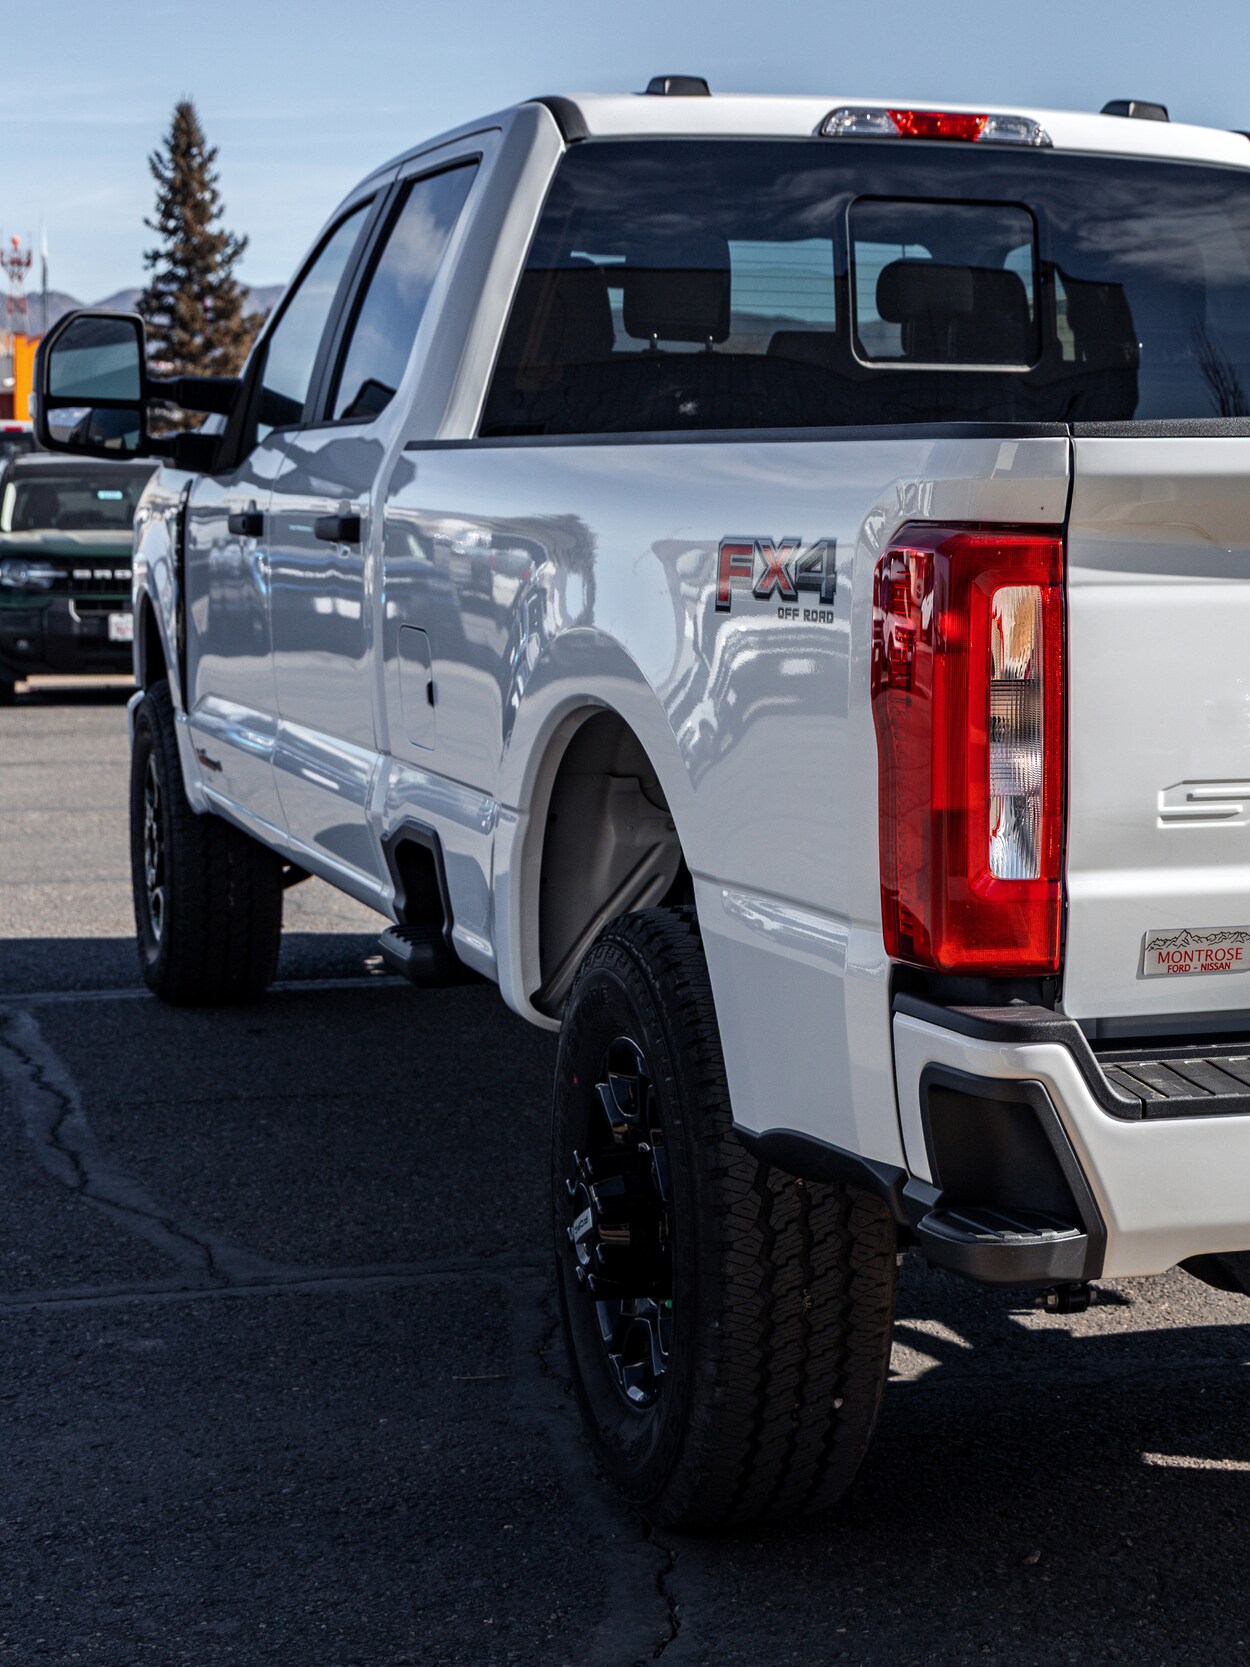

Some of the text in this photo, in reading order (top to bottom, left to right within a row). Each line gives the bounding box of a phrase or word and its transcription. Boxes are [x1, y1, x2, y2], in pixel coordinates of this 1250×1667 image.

[715, 536, 837, 613] FX4
[777, 606, 834, 624] OFF ROAD
[1157, 947, 1244, 964] MONTROSE
[1167, 964, 1191, 973] FORD
[1200, 962, 1231, 971] NISSAN
